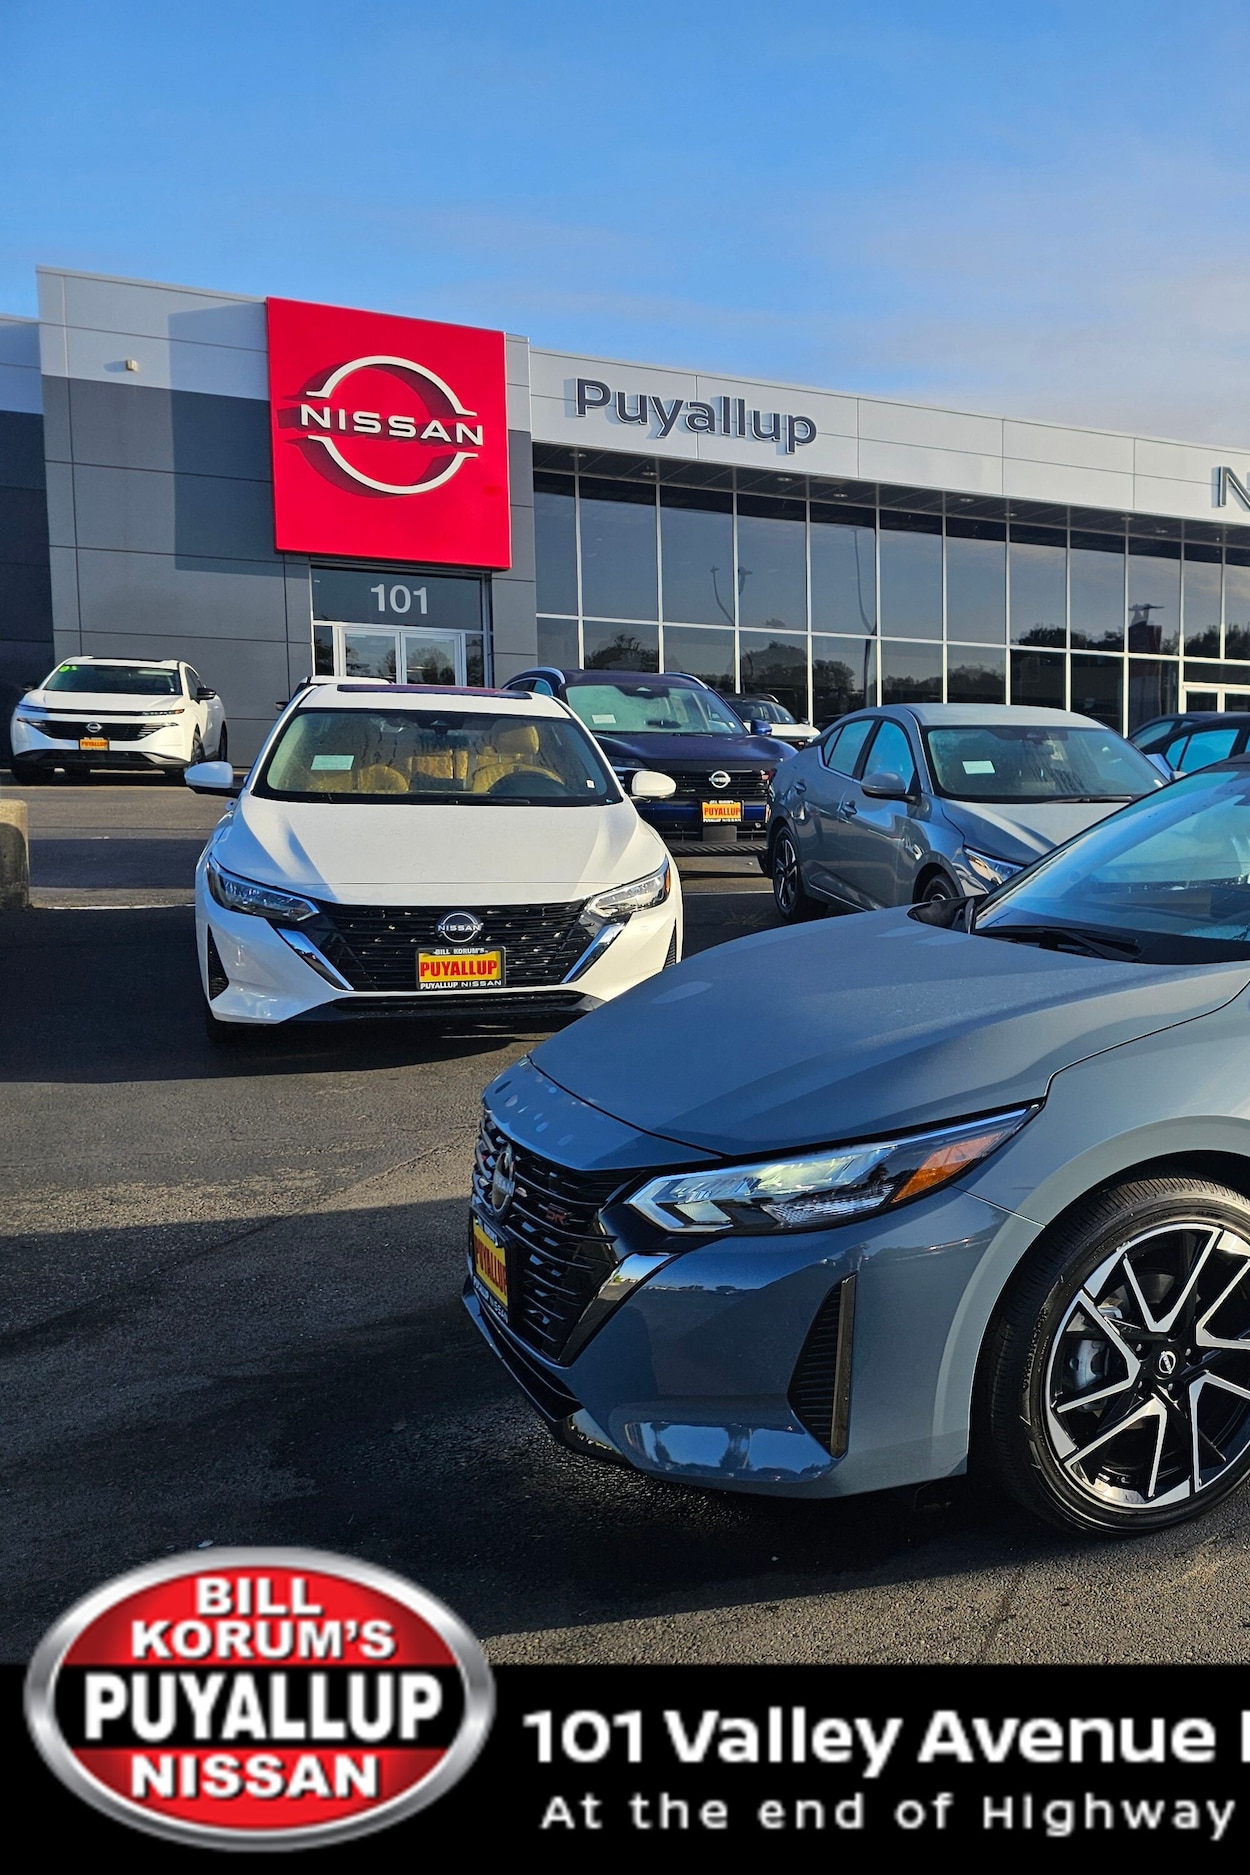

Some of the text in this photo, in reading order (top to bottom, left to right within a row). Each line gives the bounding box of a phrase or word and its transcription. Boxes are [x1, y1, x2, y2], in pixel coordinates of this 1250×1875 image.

[300, 403, 483, 446] NISSAN
[575, 378, 817, 454] Puyallup
[370, 583, 428, 615] 101
[703, 807, 741, 816] PUYALLUP
[437, 924, 482, 932] NISSAN
[420, 960, 498, 977] PUYALLUP
[420, 980, 502, 990] PUYALLUP NISSAN
